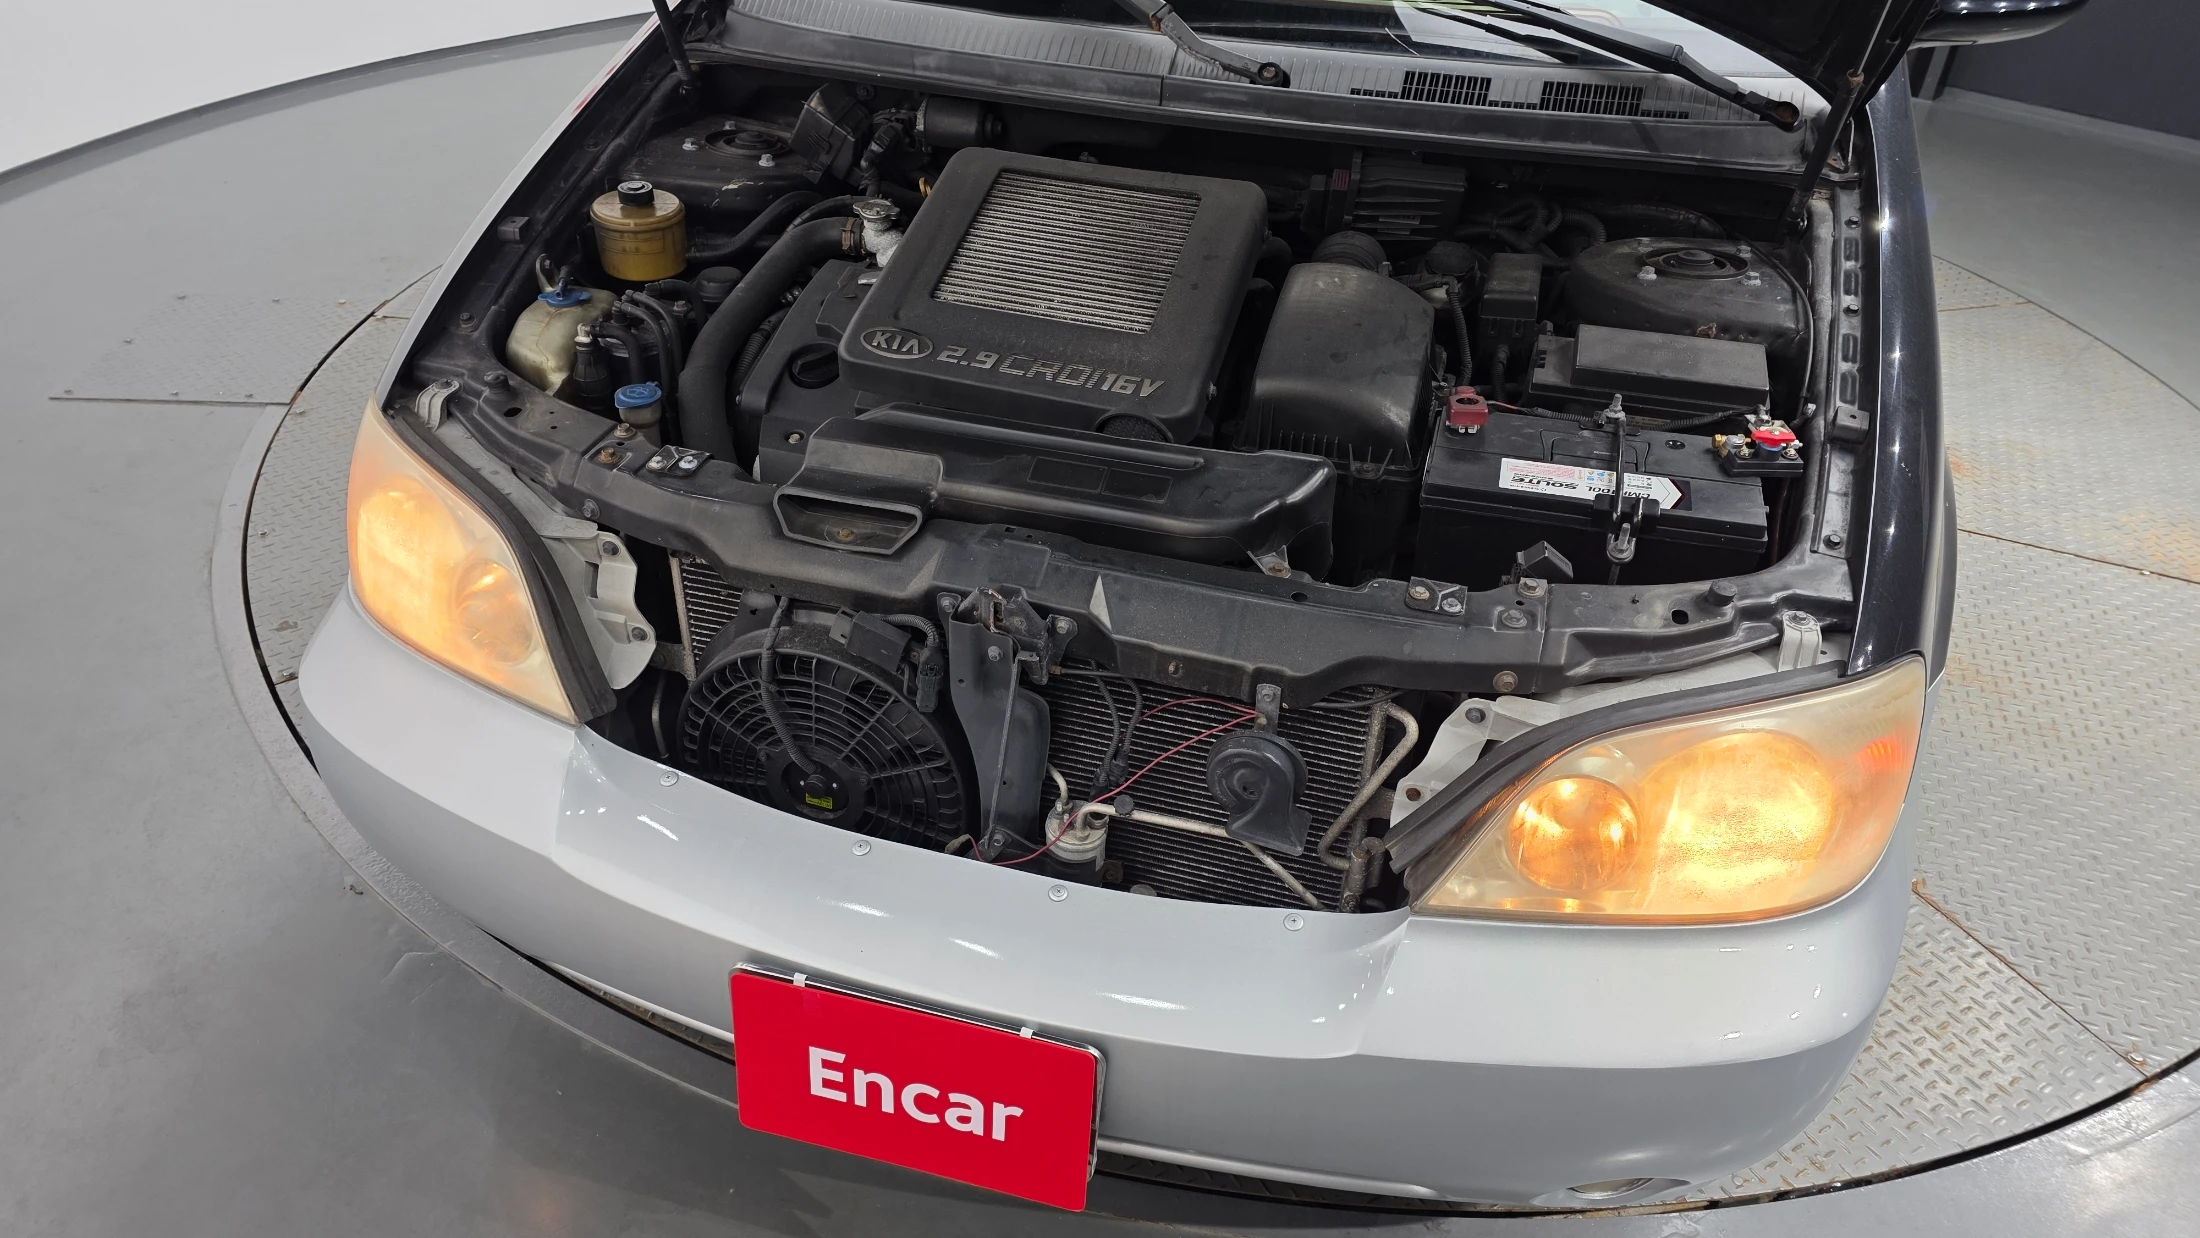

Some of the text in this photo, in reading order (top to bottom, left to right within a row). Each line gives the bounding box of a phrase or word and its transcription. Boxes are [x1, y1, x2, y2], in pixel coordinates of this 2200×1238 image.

[872, 331, 919, 354] KIA
[1510, 477, 1579, 490] SOLITE
[808, 1046, 1024, 1142] Encar
